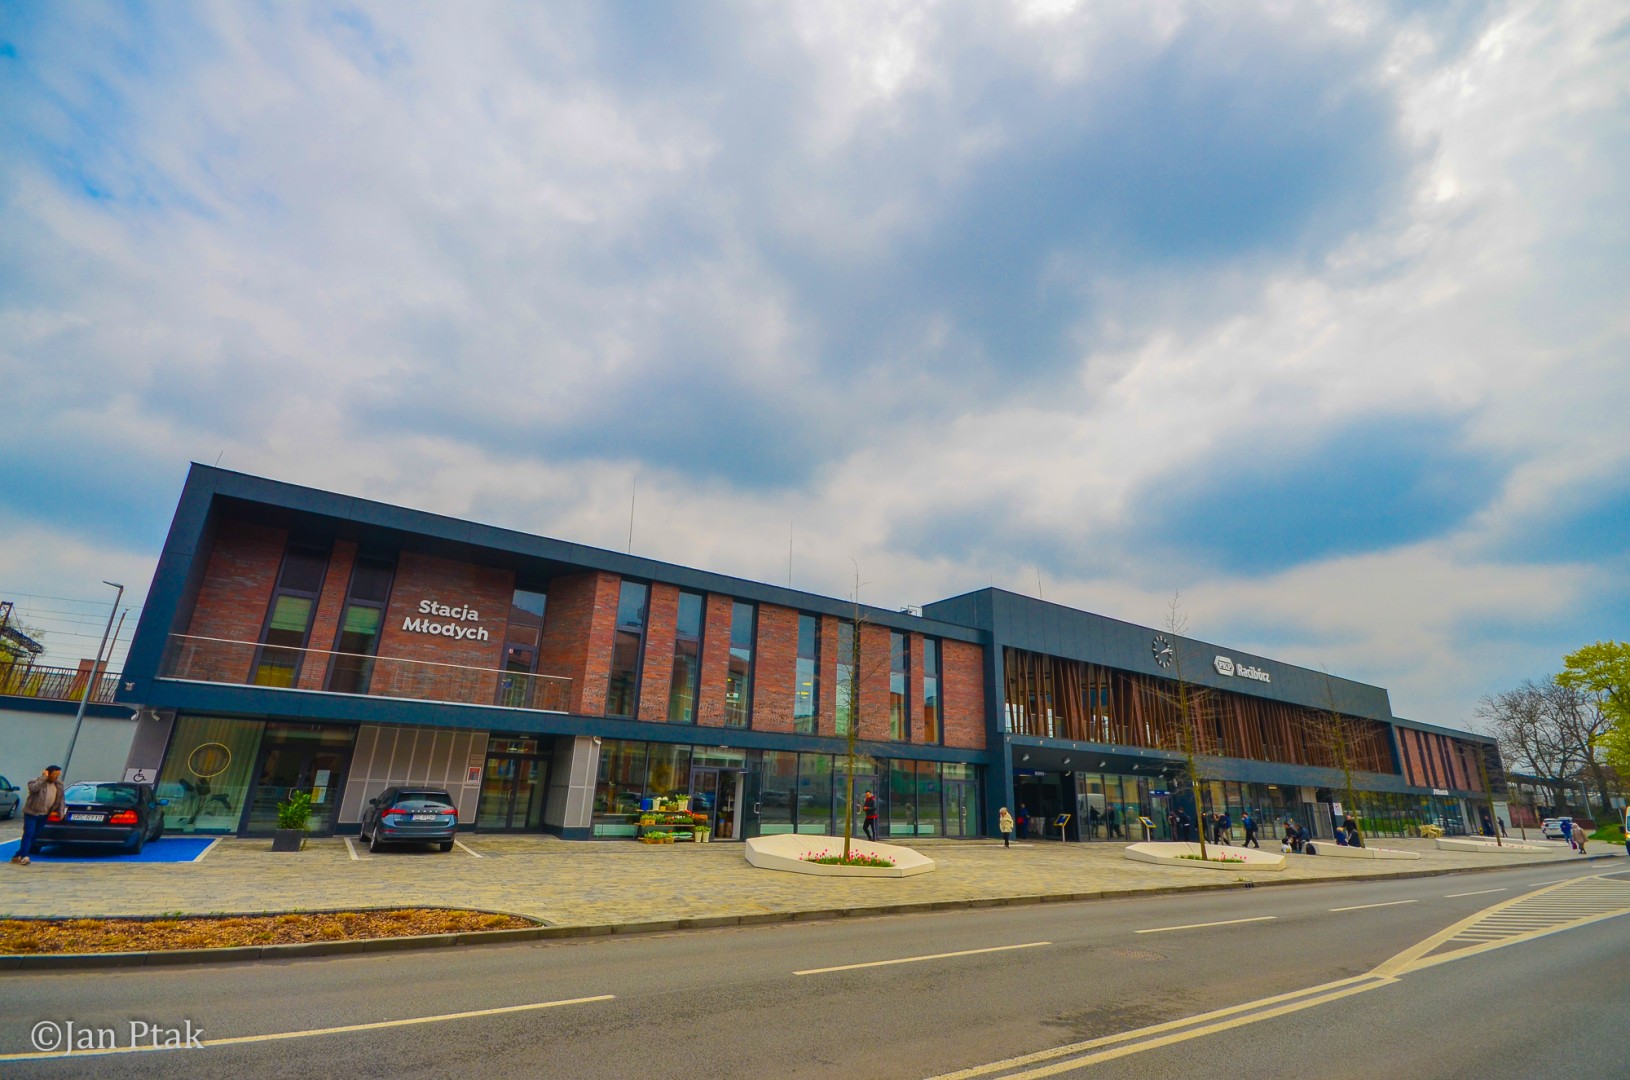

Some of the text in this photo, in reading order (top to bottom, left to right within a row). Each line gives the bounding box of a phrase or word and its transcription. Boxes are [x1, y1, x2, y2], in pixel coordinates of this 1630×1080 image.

[418, 600, 479, 621] Stacja
[402, 616, 489, 641] Młodych
[1236, 663, 1271, 683] Racibórz
